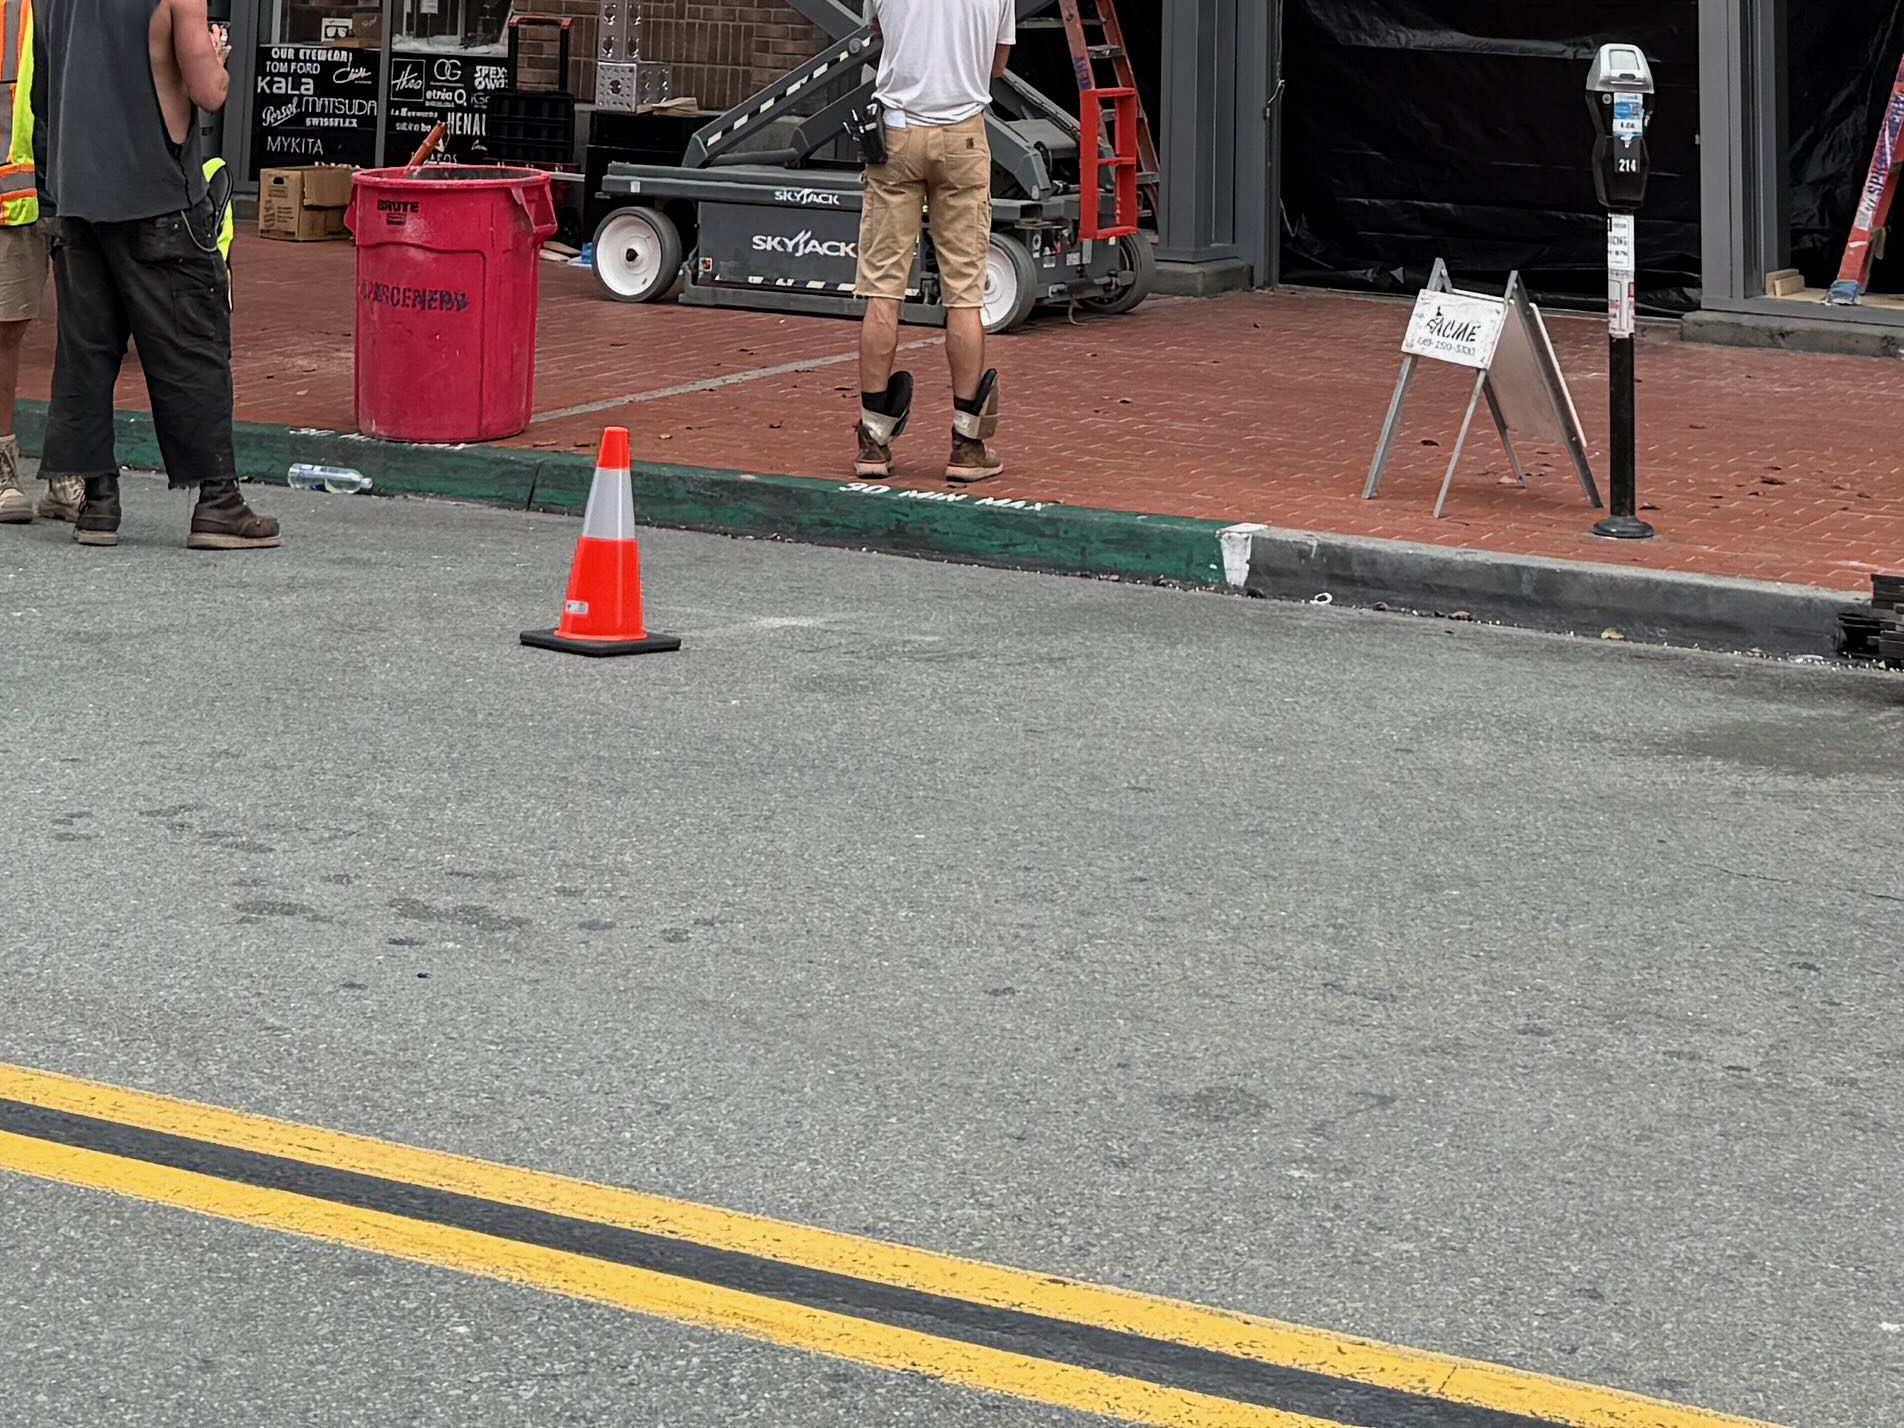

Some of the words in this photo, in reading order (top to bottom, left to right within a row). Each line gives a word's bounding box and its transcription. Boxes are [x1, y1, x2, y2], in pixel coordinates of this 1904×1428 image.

[271, 48, 295, 59] OUR
[266, 61, 288, 73] TOM
[290, 62, 321, 74] FORD
[266, 135, 324, 155] MYKITA
[774, 188, 840, 205] SKYJACK
[752, 229, 857, 258] SKYJACK
[1431, 317, 1482, 343] ACME
